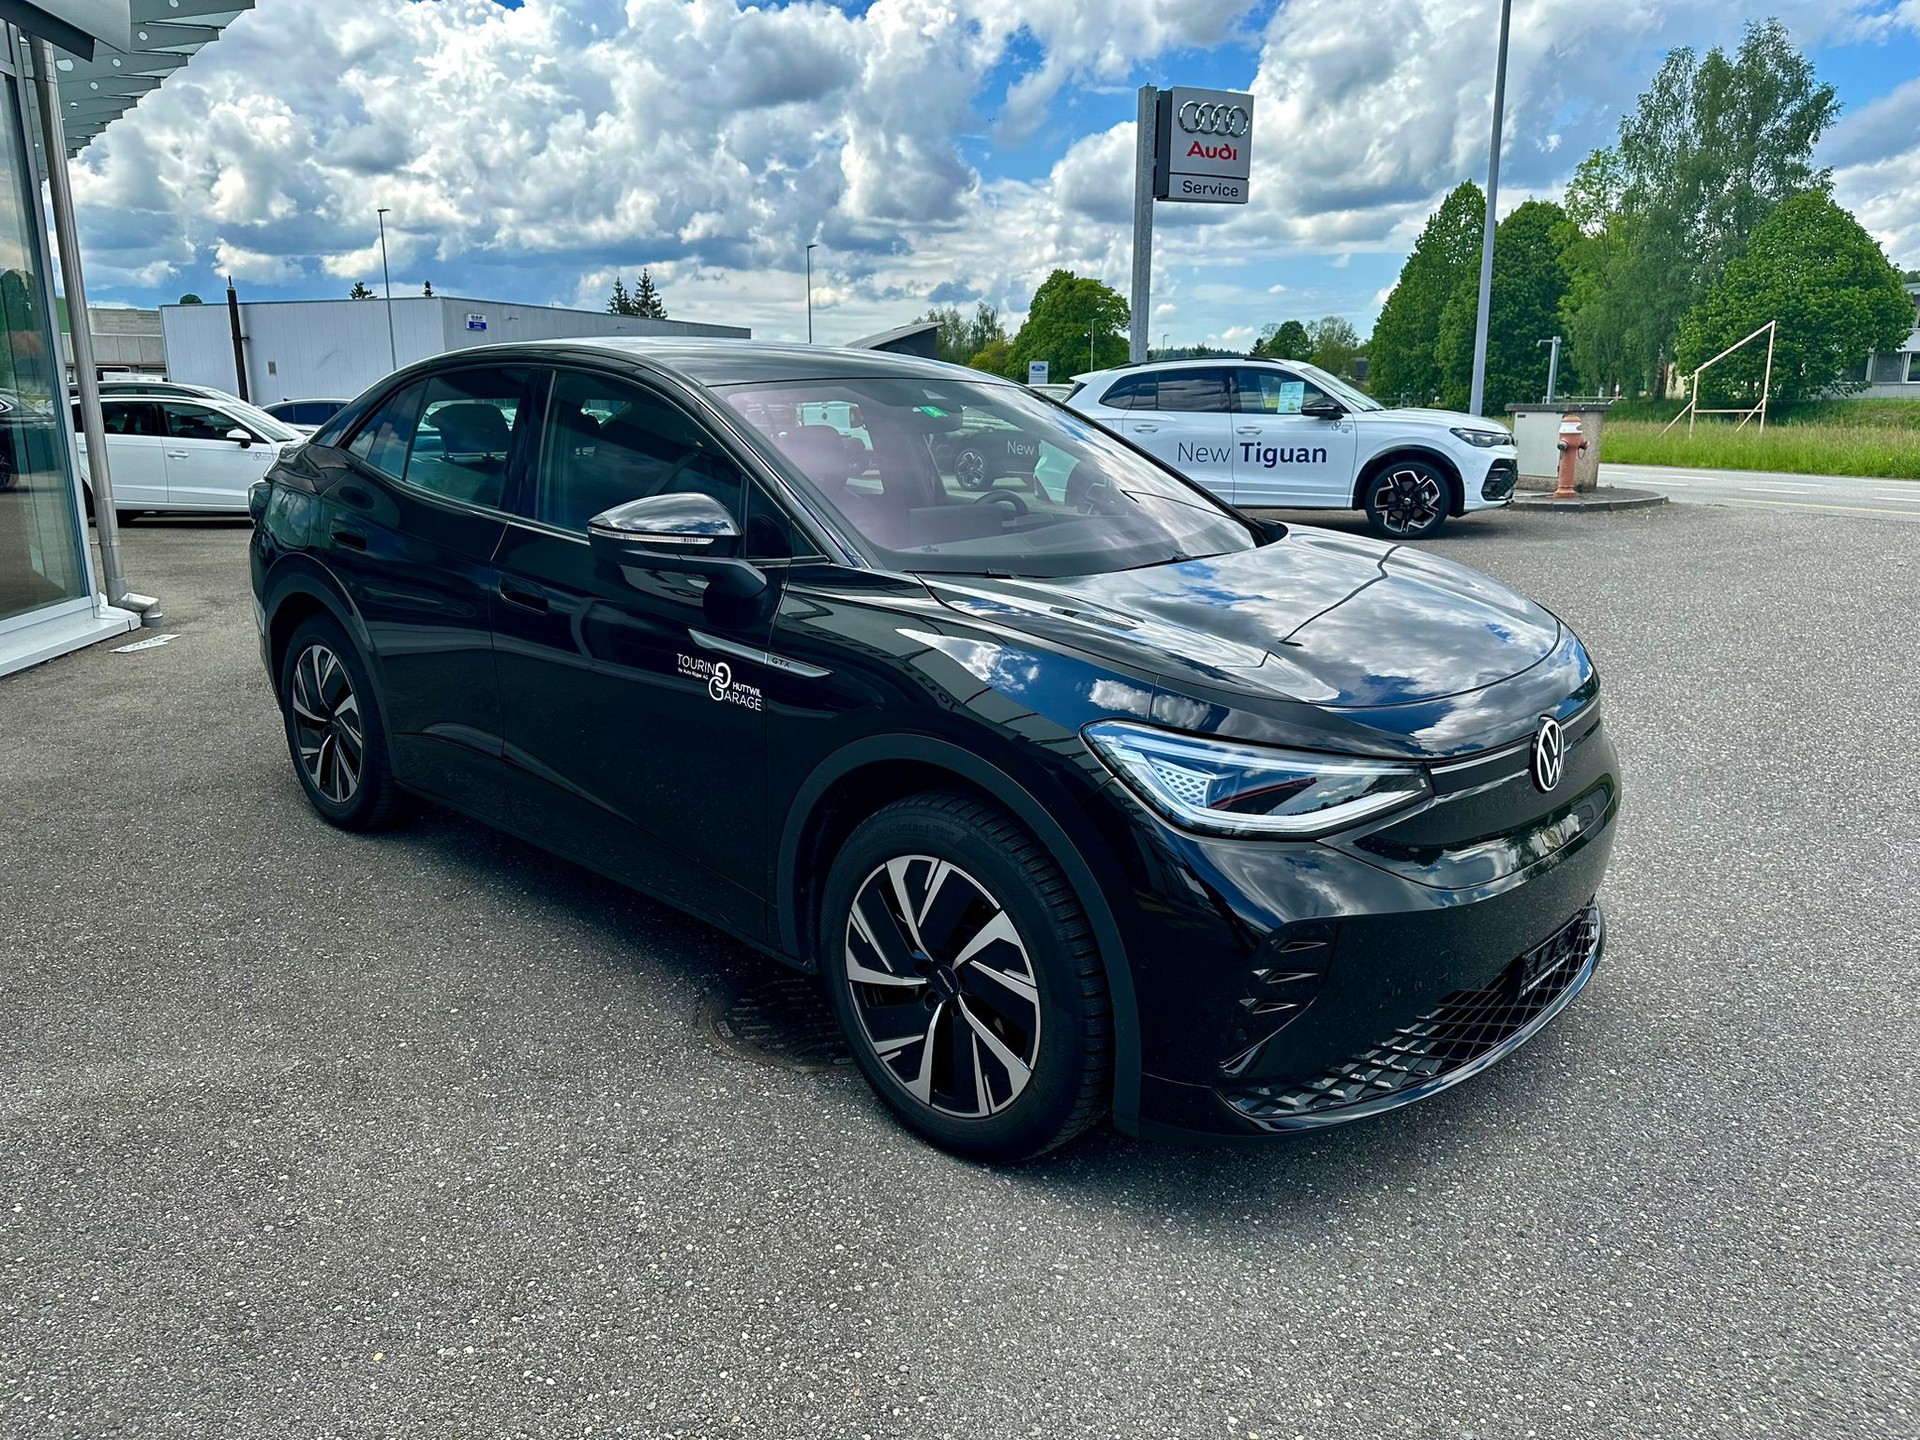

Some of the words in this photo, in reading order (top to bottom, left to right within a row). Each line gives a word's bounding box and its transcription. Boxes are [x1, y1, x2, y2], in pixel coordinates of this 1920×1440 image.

[1186, 140, 1238, 161] Audi
[1182, 180, 1239, 197] Service
[1006, 440, 1035, 455] New
[1177, 441, 1231, 462] New
[1239, 441, 1328, 469] Tiguan
[771, 656, 790, 668] GTX
[732, 681, 763, 699] HUTTWIL
